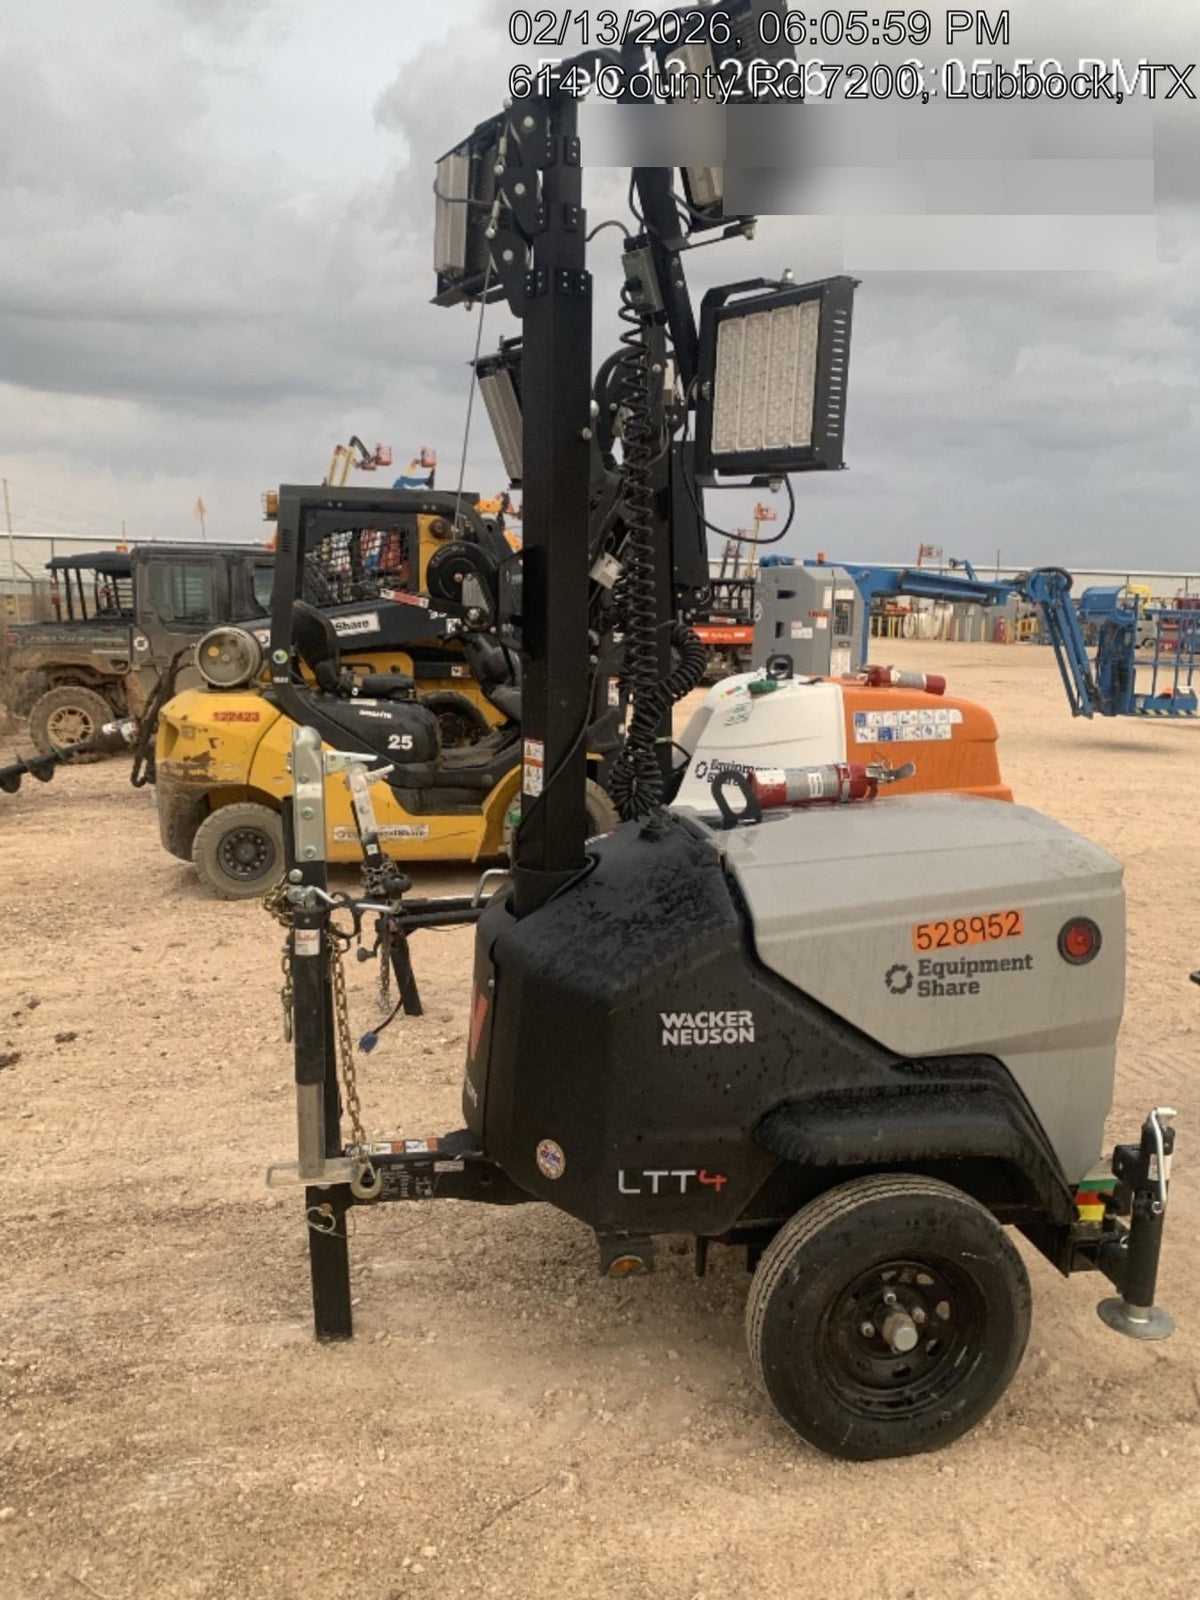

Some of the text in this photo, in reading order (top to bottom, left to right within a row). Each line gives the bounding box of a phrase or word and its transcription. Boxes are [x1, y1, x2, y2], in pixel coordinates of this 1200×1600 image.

[387, 734, 413, 750] 25
[916, 910, 1022, 950] 528952
[917, 953, 1034, 979] Equipment
[917, 979, 980, 997] Share
[660, 1010, 754, 1028] WACKER
[661, 1027, 755, 1046] NEUSON
[617, 1169, 727, 1194] LTT4
